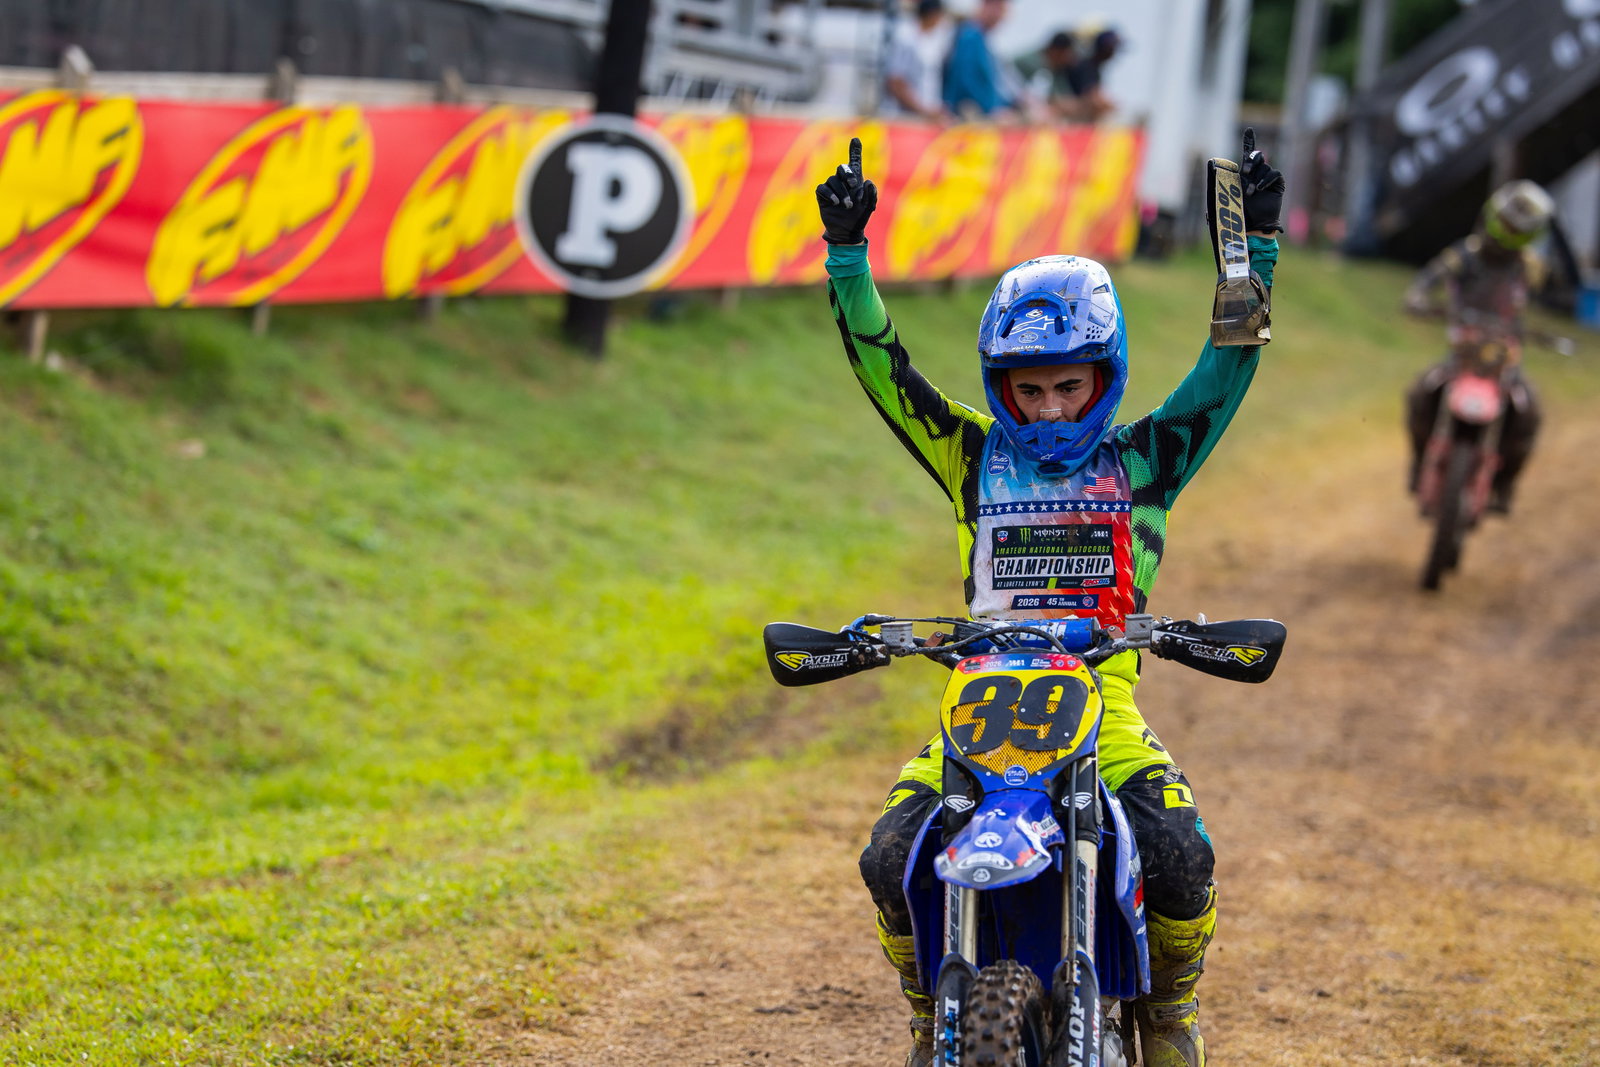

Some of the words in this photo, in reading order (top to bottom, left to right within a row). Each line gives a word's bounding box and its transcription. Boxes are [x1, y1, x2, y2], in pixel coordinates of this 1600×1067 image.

[0, 93, 137, 251] MF
[146, 105, 362, 306] FMF
[554, 141, 664, 267] P
[996, 547, 1026, 555] AMATEUR
[1029, 546, 1064, 554] NATIONAL
[1067, 545, 1110, 553] MOTOCROSS
[996, 557, 1110, 576] CHAMPIONSHIP
[1017, 598, 1040, 607] 2026
[1046, 597, 1058, 606] 45
[801, 653, 847, 666] CYCRA
[951, 675, 1089, 755] 39
